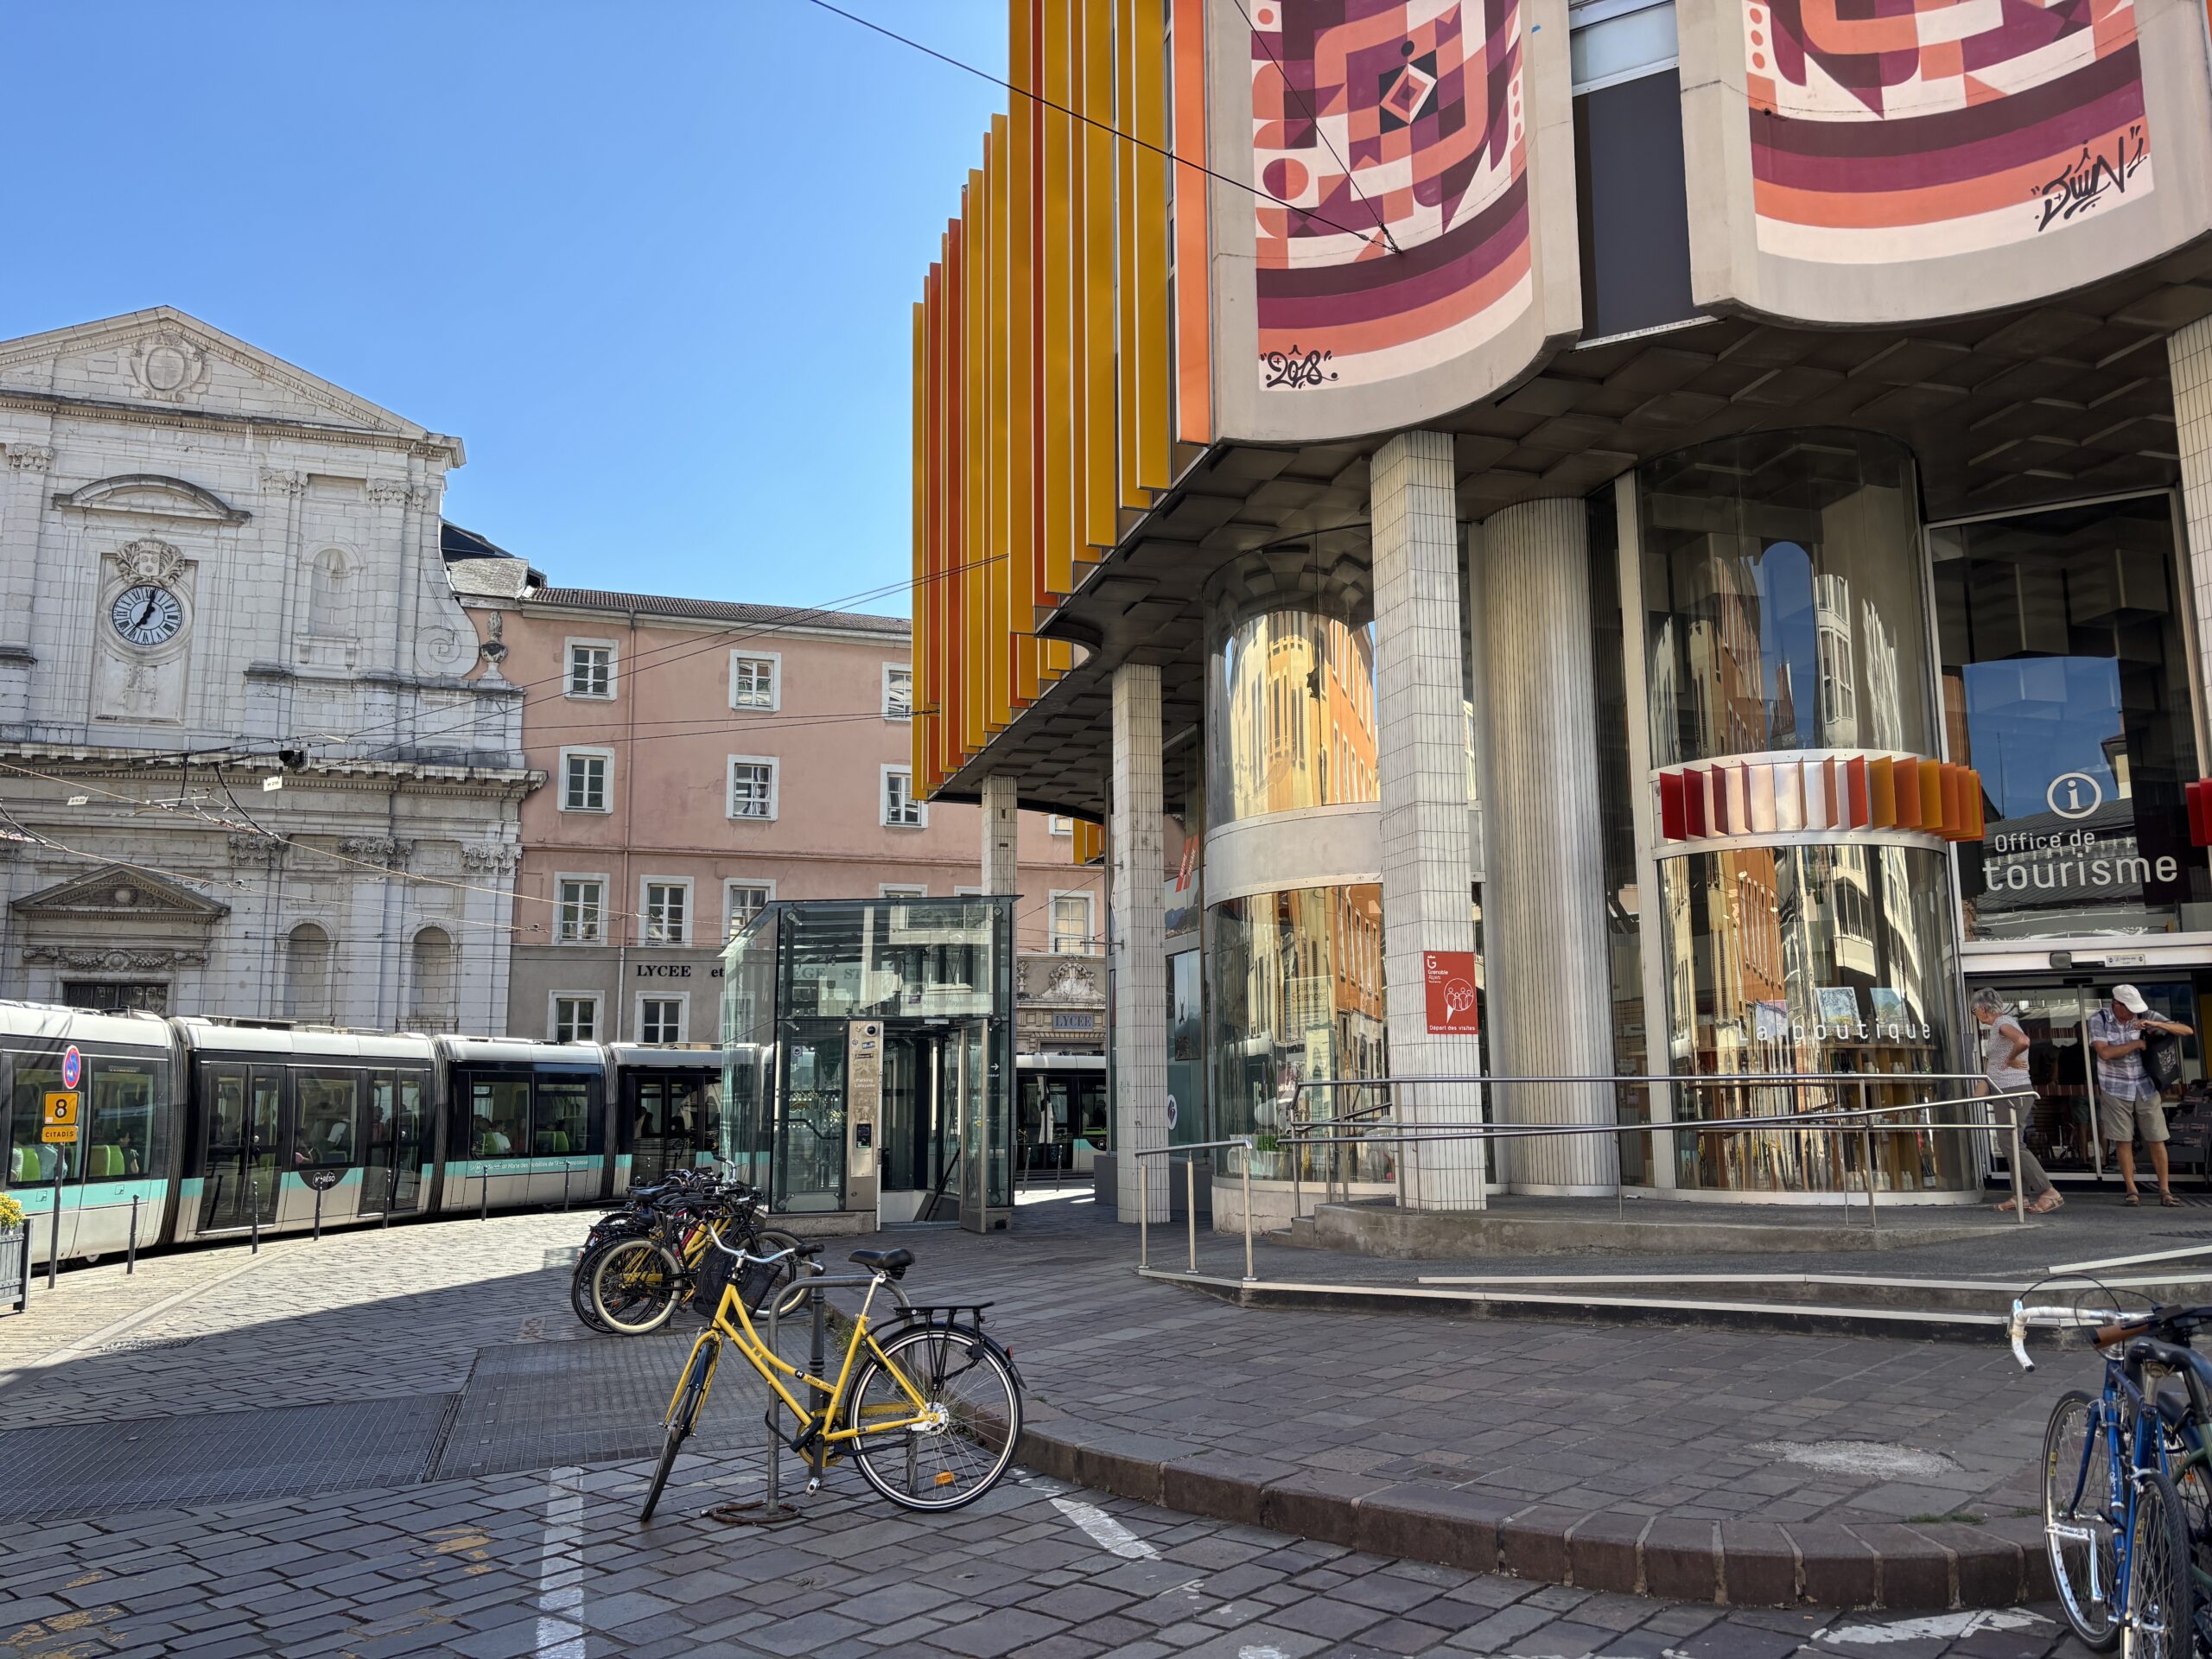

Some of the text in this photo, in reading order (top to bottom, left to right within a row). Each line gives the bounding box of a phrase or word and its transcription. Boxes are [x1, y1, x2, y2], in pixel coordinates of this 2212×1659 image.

[1995, 829, 2095, 853] Office de
[1982, 852, 2178, 891] tourisme
[637, 965, 692, 977] LYCEE
[711, 966, 724, 977] et
[1055, 1015, 1091, 1027] LYCEE
[1738, 1018, 1931, 1044] La boutique
[55, 1099, 67, 1119] 8
